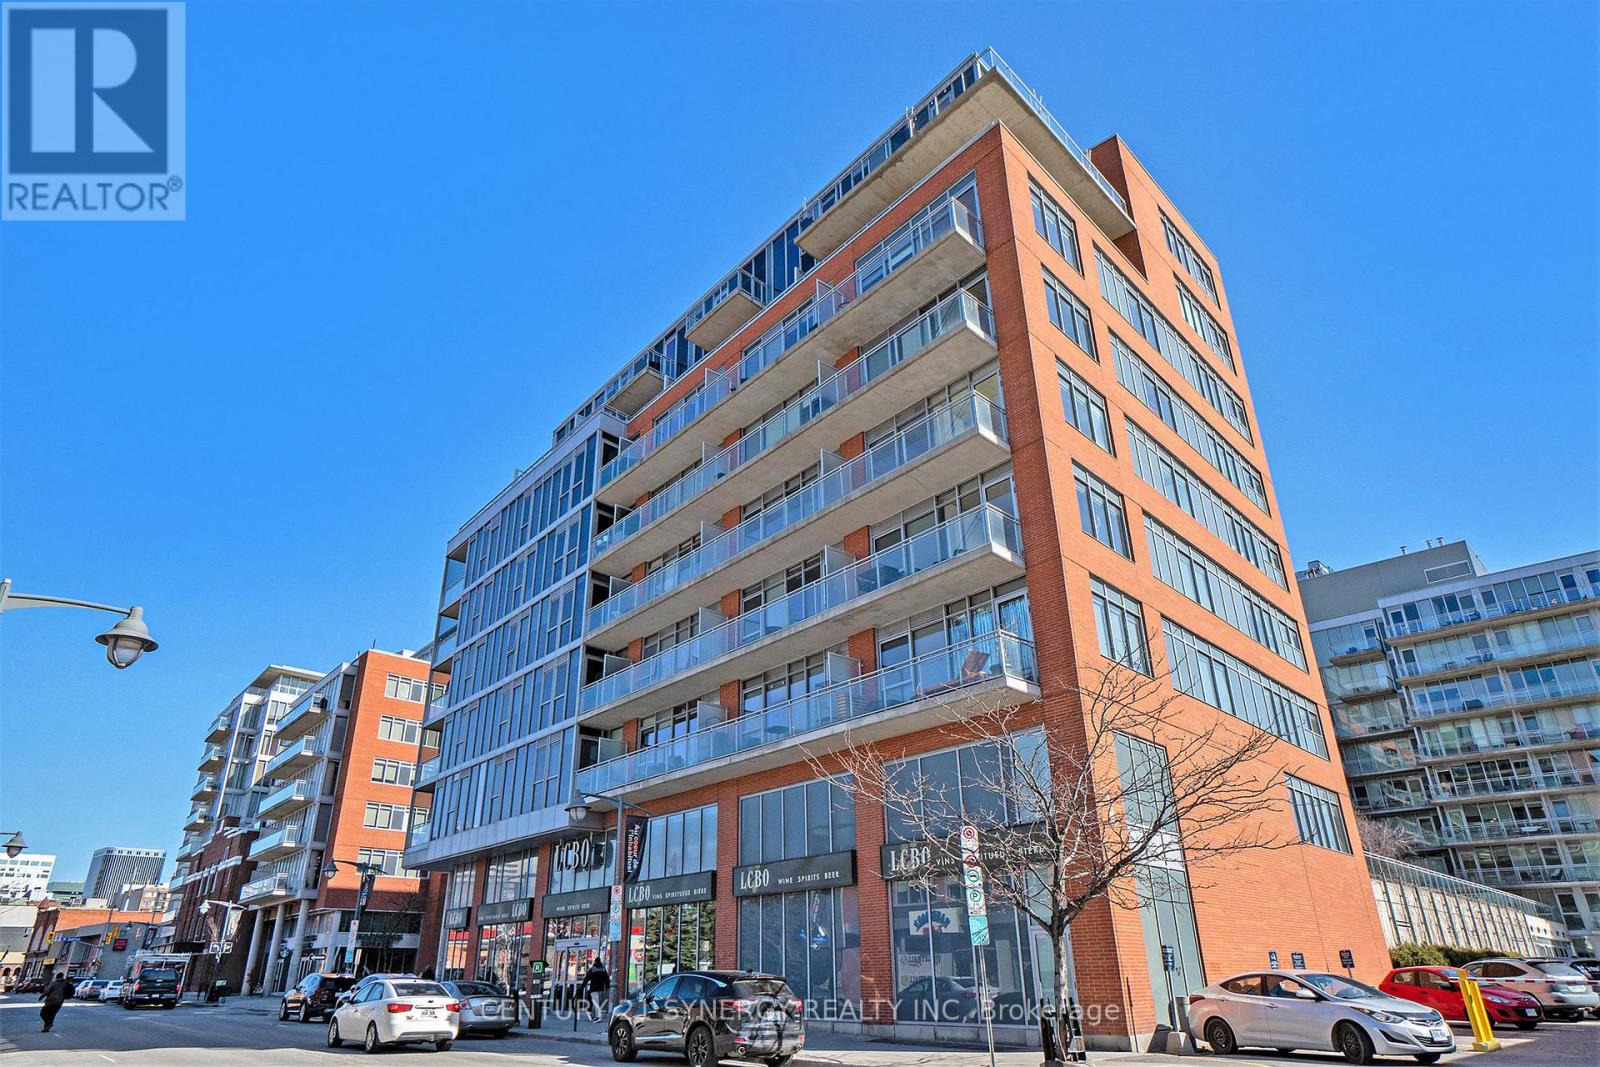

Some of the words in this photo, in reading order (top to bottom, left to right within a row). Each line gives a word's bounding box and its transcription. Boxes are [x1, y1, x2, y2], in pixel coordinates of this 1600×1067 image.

[555, 838, 590, 872] LCBO
[890, 845, 931, 872] LCBO
[935, 857, 955, 866] VINS
[740, 868, 769, 890] LCBO
[797, 873, 820, 883] SPIRITS
[824, 870, 840, 880] BEER
[628, 885, 651, 903] LCBO
